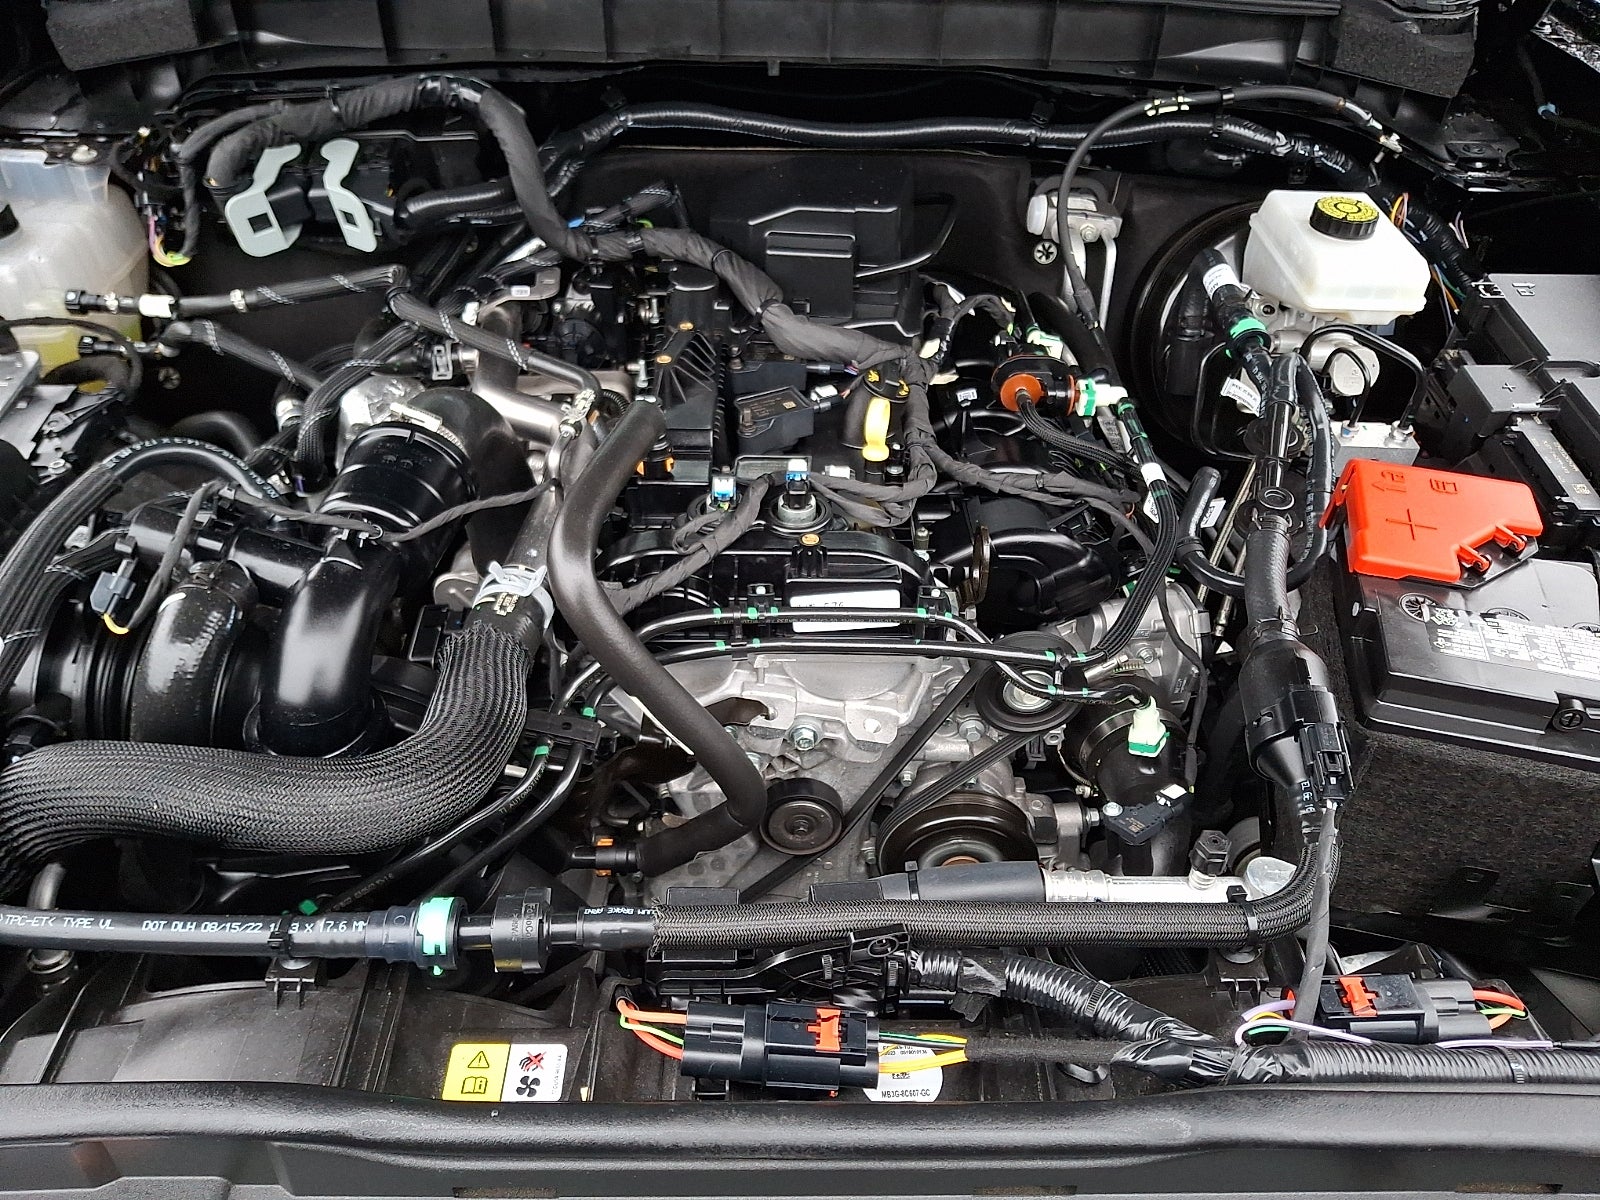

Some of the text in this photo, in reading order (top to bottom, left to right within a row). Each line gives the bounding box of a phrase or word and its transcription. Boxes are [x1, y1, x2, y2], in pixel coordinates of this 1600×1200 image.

[607, 907, 634, 915] BRAKE
[63, 917, 95, 929] TYPE
[142, 920, 167, 931] DOT
[200, 921, 262, 933] 08/15/22
[319, 919, 347, 933] 17.6
